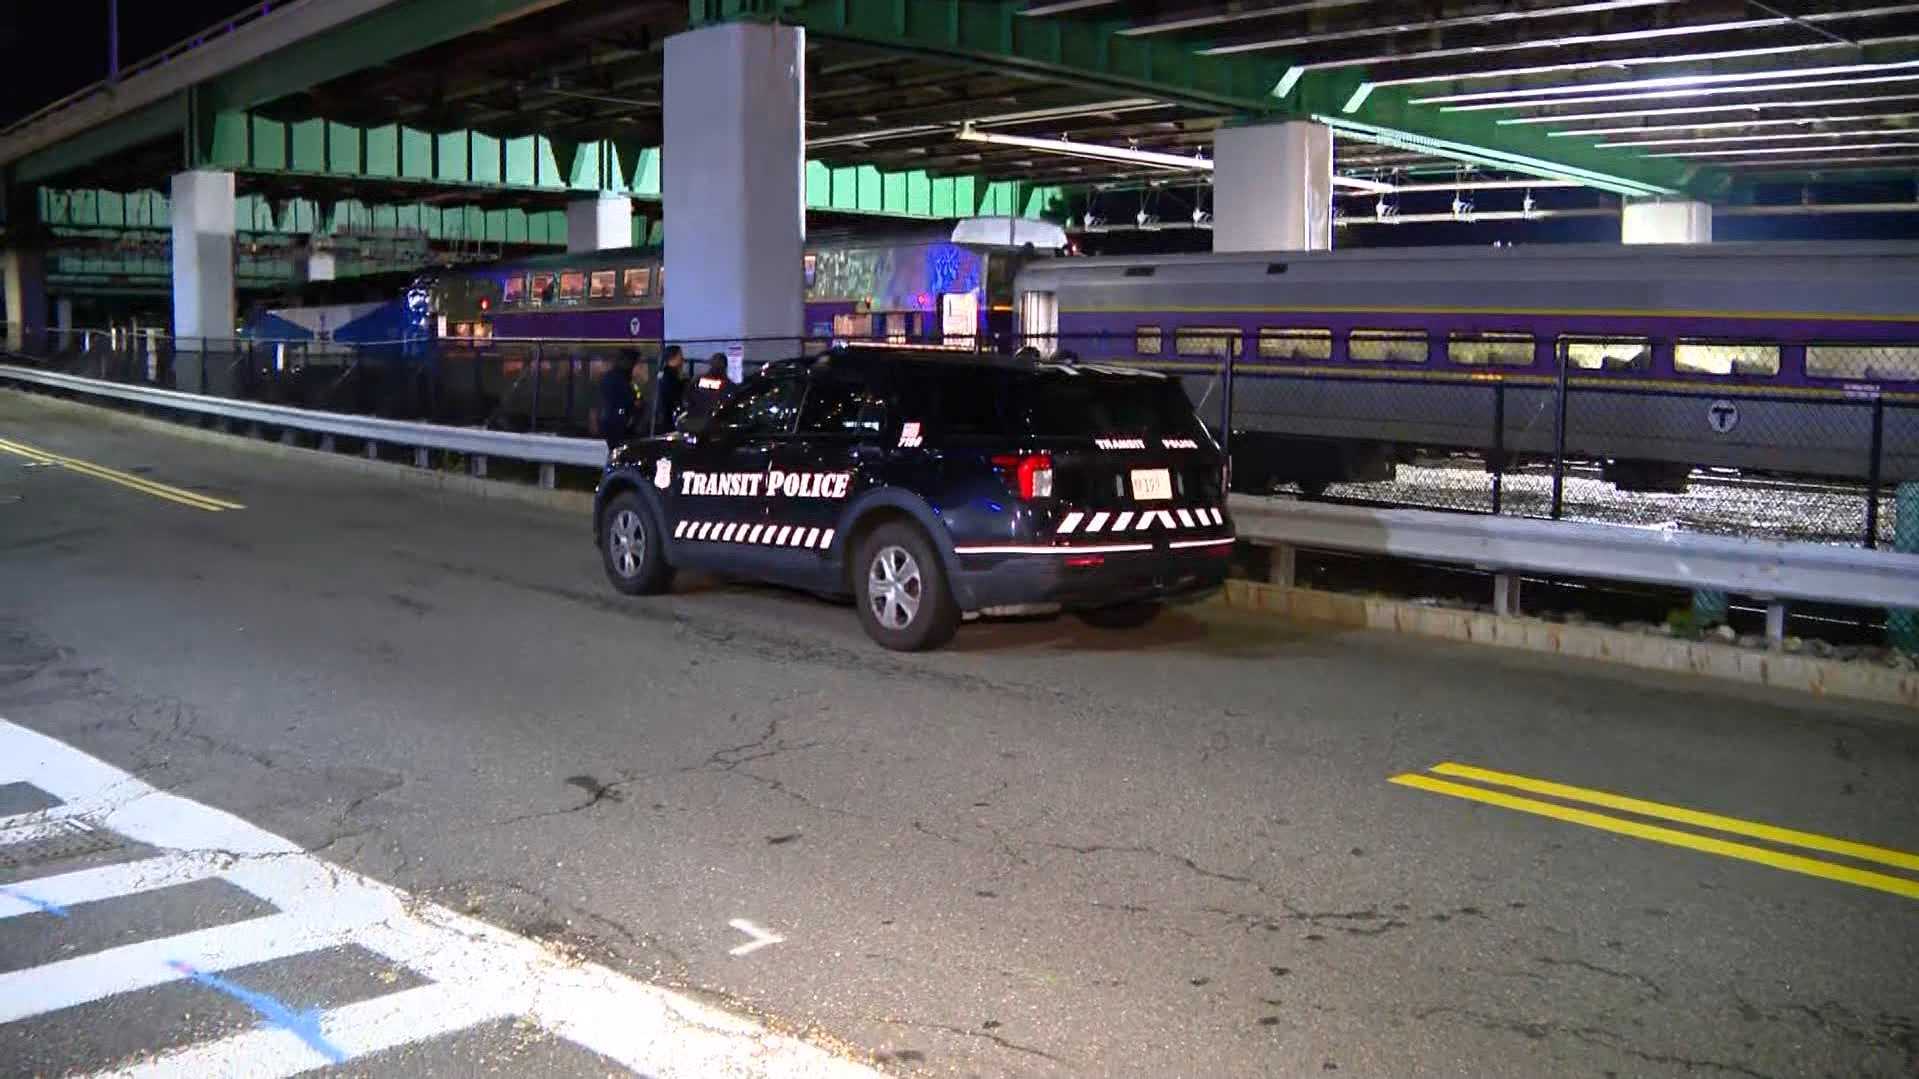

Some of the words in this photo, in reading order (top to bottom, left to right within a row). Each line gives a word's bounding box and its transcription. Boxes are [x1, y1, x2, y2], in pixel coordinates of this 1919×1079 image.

[1711, 405, 1735, 429] T
[681, 471, 762, 496] TRANSIT
[766, 470, 849, 498] POLICE
